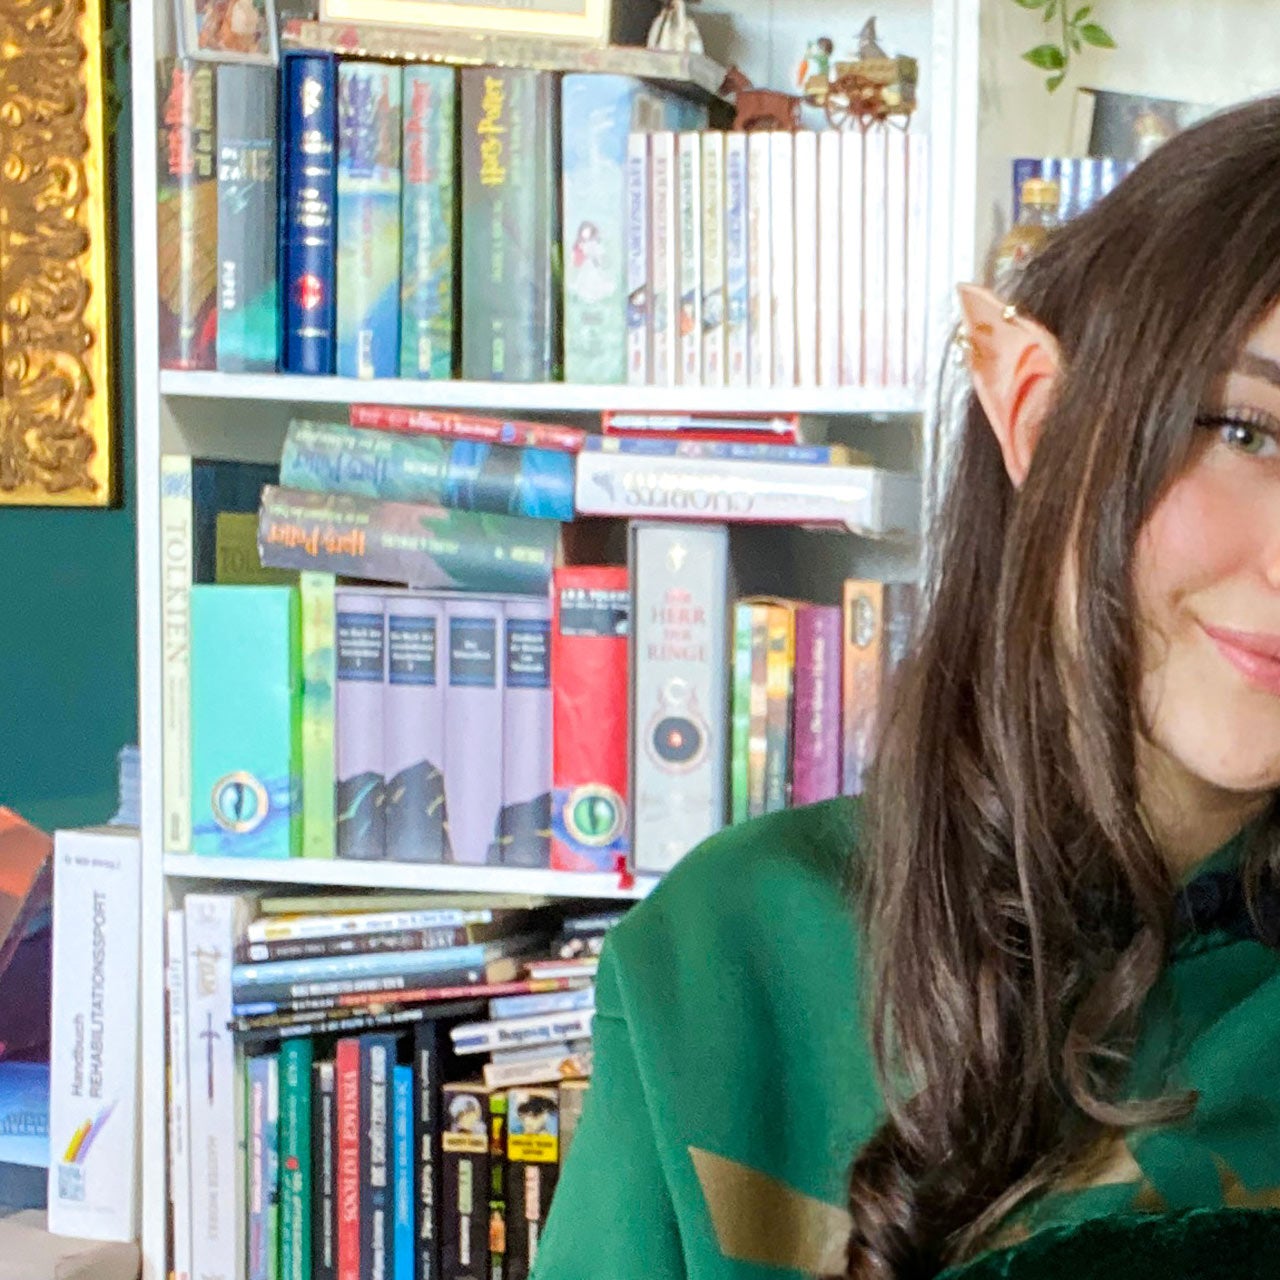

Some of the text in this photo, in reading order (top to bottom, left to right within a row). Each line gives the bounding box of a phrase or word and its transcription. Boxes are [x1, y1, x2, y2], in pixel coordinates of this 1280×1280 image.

[166, 519, 189, 664] TOLKIEN
[70, 1012, 86, 1098] Handbuch
[90, 890, 107, 1099] REHABILITATIONSSPORT
